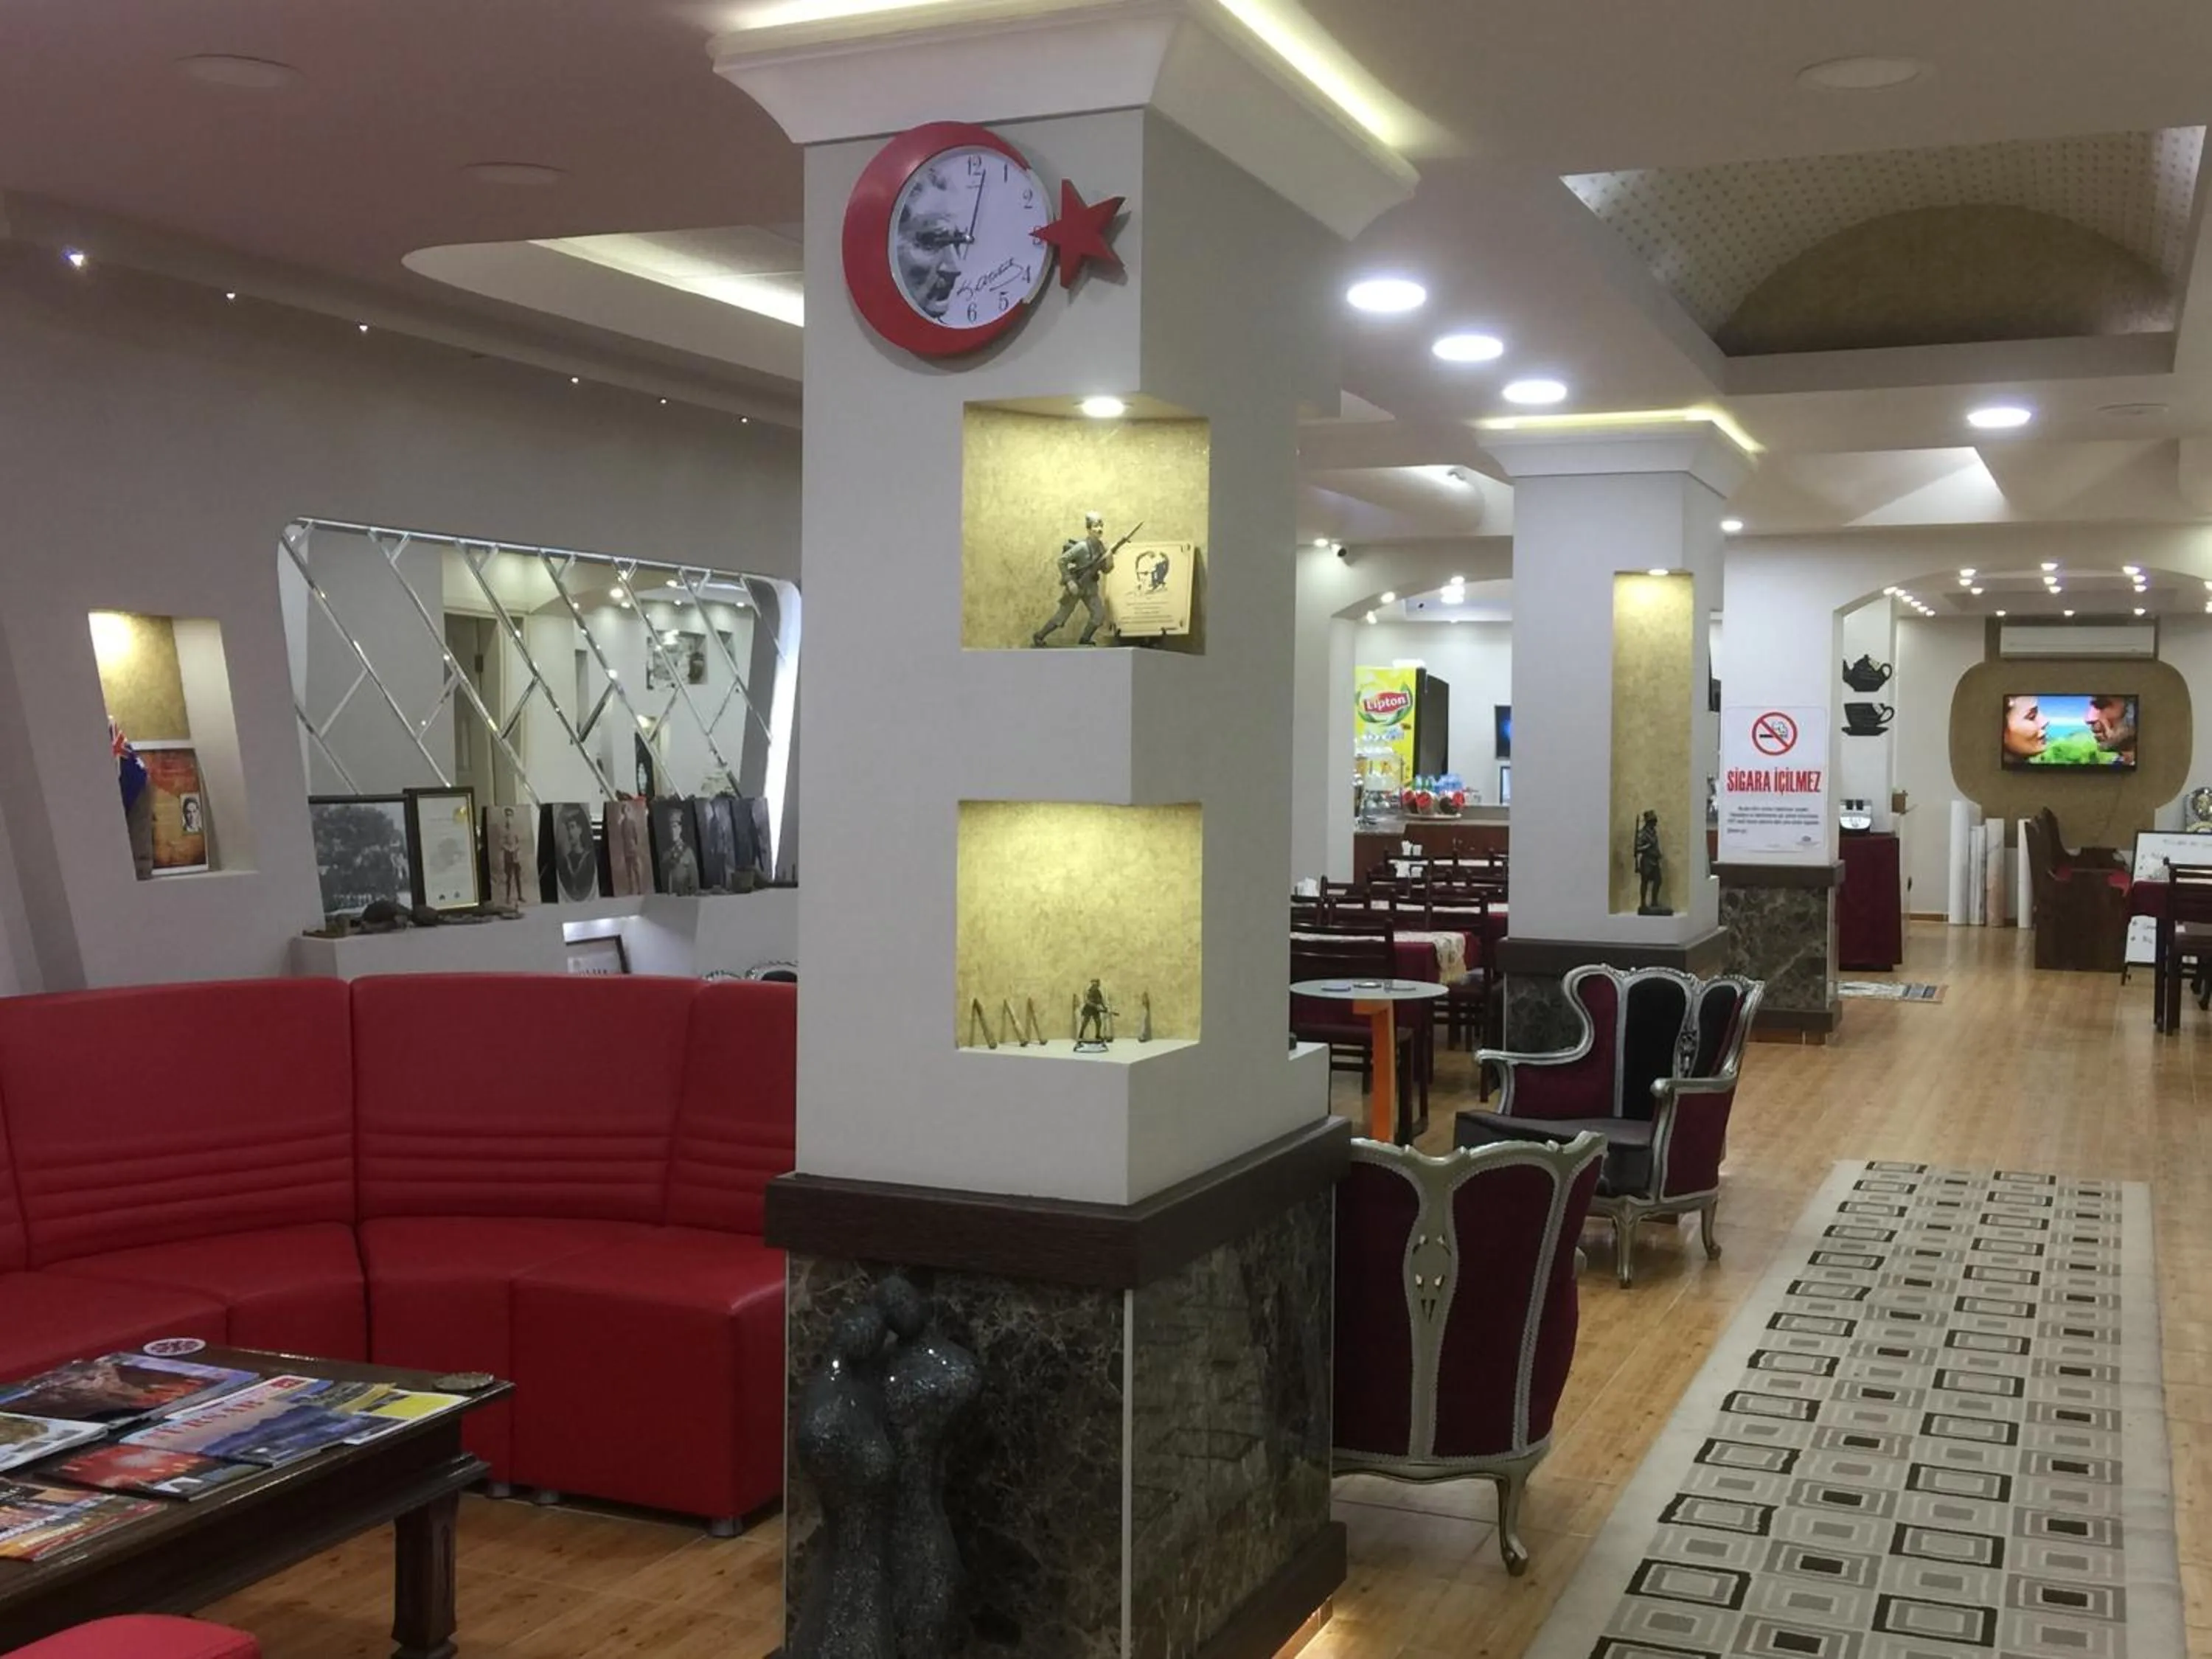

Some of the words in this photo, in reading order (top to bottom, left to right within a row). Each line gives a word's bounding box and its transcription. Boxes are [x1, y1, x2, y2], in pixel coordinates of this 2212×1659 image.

[967, 155, 982, 176] 12
[1003, 164, 1009, 183] 1
[1022, 189, 1034, 209] 2
[1021, 265, 1032, 284] 4
[998, 291, 1009, 310] 5
[967, 302, 978, 323] 6
[1366, 696, 1405, 711] Lipton
[1727, 767, 1771, 793] SİGARA
[1774, 767, 1821, 795] İÇİLMEZ
